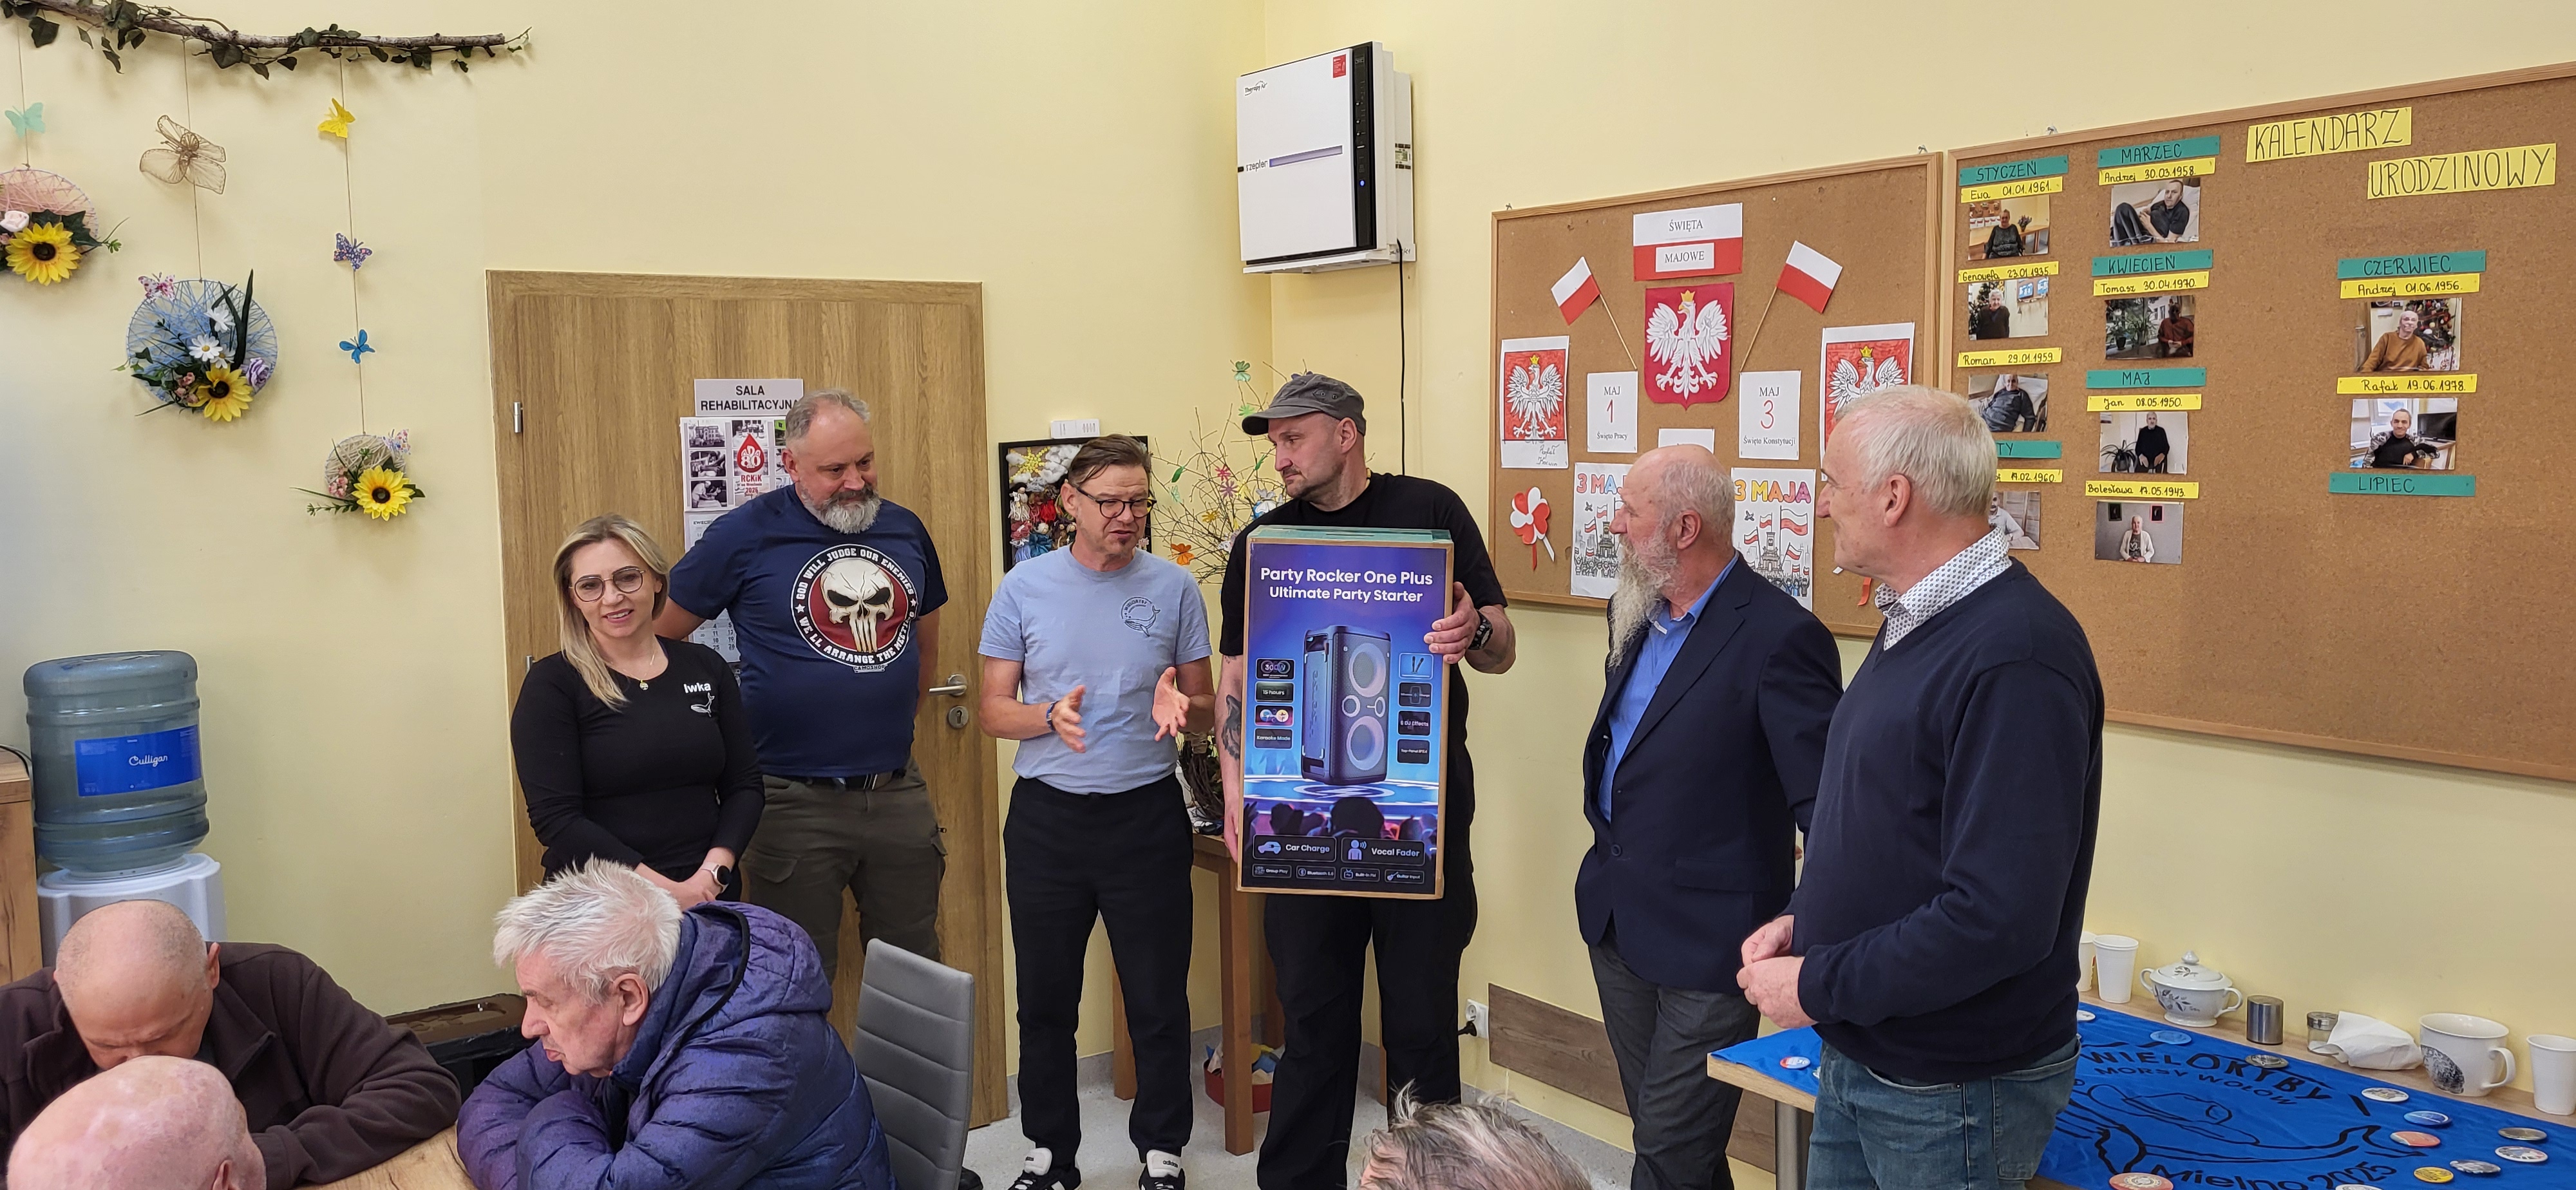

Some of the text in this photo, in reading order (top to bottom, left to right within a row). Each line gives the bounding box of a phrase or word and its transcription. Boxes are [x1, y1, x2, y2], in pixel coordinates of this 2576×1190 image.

[2255, 110, 2403, 159] KALENDARZ
[2121, 144, 2182, 164] MARZEC
[1976, 161, 2037, 182] STYCZEŃ
[2105, 171, 2136, 183] Andrzej
[2371, 148, 2551, 196] URODZINOWY
[1971, 190, 1991, 200] Ewa
[1669, 219, 1703, 232] ŚWIĘTA
[1664, 250, 1705, 263] MAJOWE
[2108, 255, 2175, 274] KWIECIEŃ
[2363, 255, 2451, 275] CZERWIEC
[1962, 270, 2000, 281] Genowefa
[2101, 283, 2136, 293] Tomasz
[2358, 285, 2396, 296] Andrzej
[1963, 355, 1996, 365] Roman
[2122, 372, 2151, 385] MAJ
[735, 385, 764, 395] SALA
[1604, 386, 1620, 395] MAJ
[1759, 386, 1780, 397] MAJ
[2361, 379, 2398, 393] Rafał
[701, 399, 798, 411] REHABILITACYJN
[2104, 397, 2125, 408] Jan
[1606, 399, 1613, 423] 1
[1760, 399, 1774, 429] 3
[1597, 431, 1613, 440] Święto
[1743, 436, 1796, 445] Święto Konstytucji
[1996, 442, 2013, 456] TY
[741, 474, 762, 482] RCKiK
[1577, 473, 1627, 495] 3 MA
[1734, 479, 1812, 504] 3 MAJA
[2087, 484, 2133, 494] Bolesława
[2358, 477, 2415, 493] LIPIEC
[796, 547, 914, 600] GOD WILL JUDGE OUR ENEMIES
[1260, 567, 1433, 585] Party Rocker One Plus
[1269, 586, 1423, 603] Ultimate Party Starter
[798, 616, 810, 634] WE
[810, 634, 823, 648] LL
[823, 645, 875, 664] ARRANGE
[876, 648, 896, 663] THE
[129, 754, 167, 768] Culligan
[1285, 844, 1330, 854] Car Charge
[1372, 847, 1420, 857] Vocal Fader
[2094, 1067, 2189, 1076] MORSY
[2151, 1161, 2397, 1190] Mielno 2025
